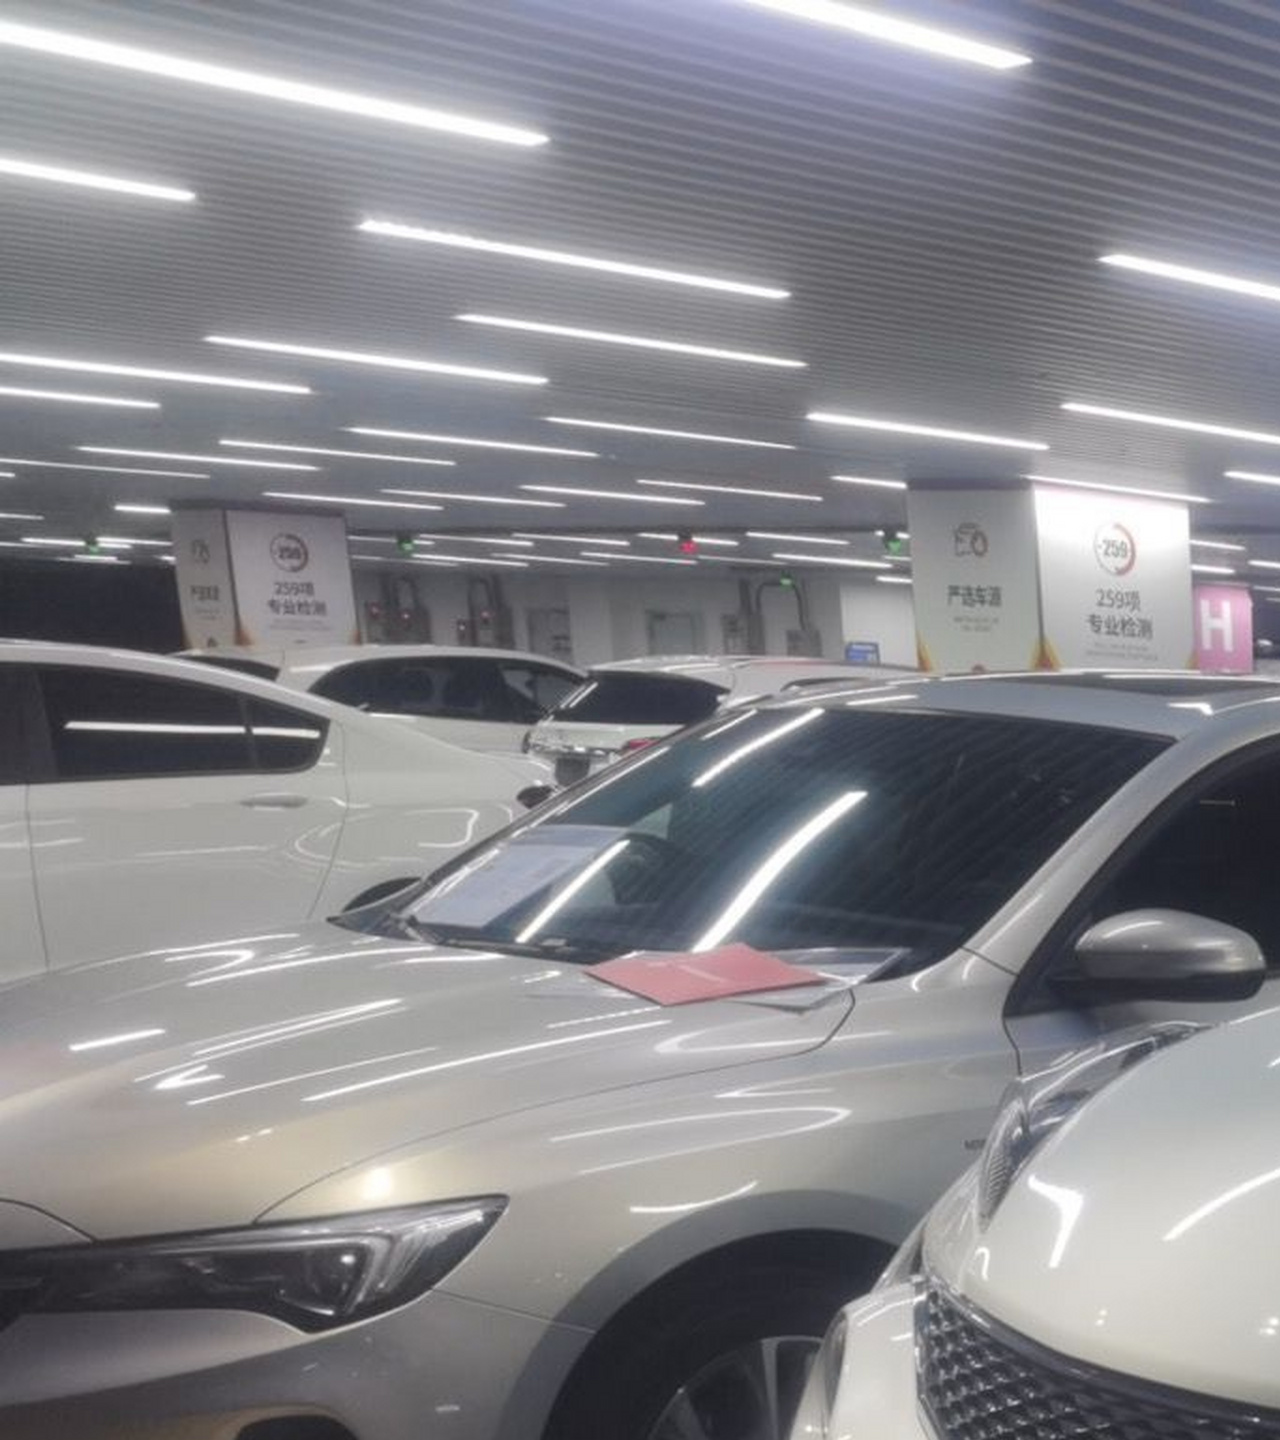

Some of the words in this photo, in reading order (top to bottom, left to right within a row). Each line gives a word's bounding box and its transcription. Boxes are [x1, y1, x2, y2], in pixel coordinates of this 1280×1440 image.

[1102, 538, 1128, 559] 259
[1095, 588, 1142, 612] 259项
[1086, 613, 1154, 640] 专业检测
[1200, 599, 1234, 653] H
